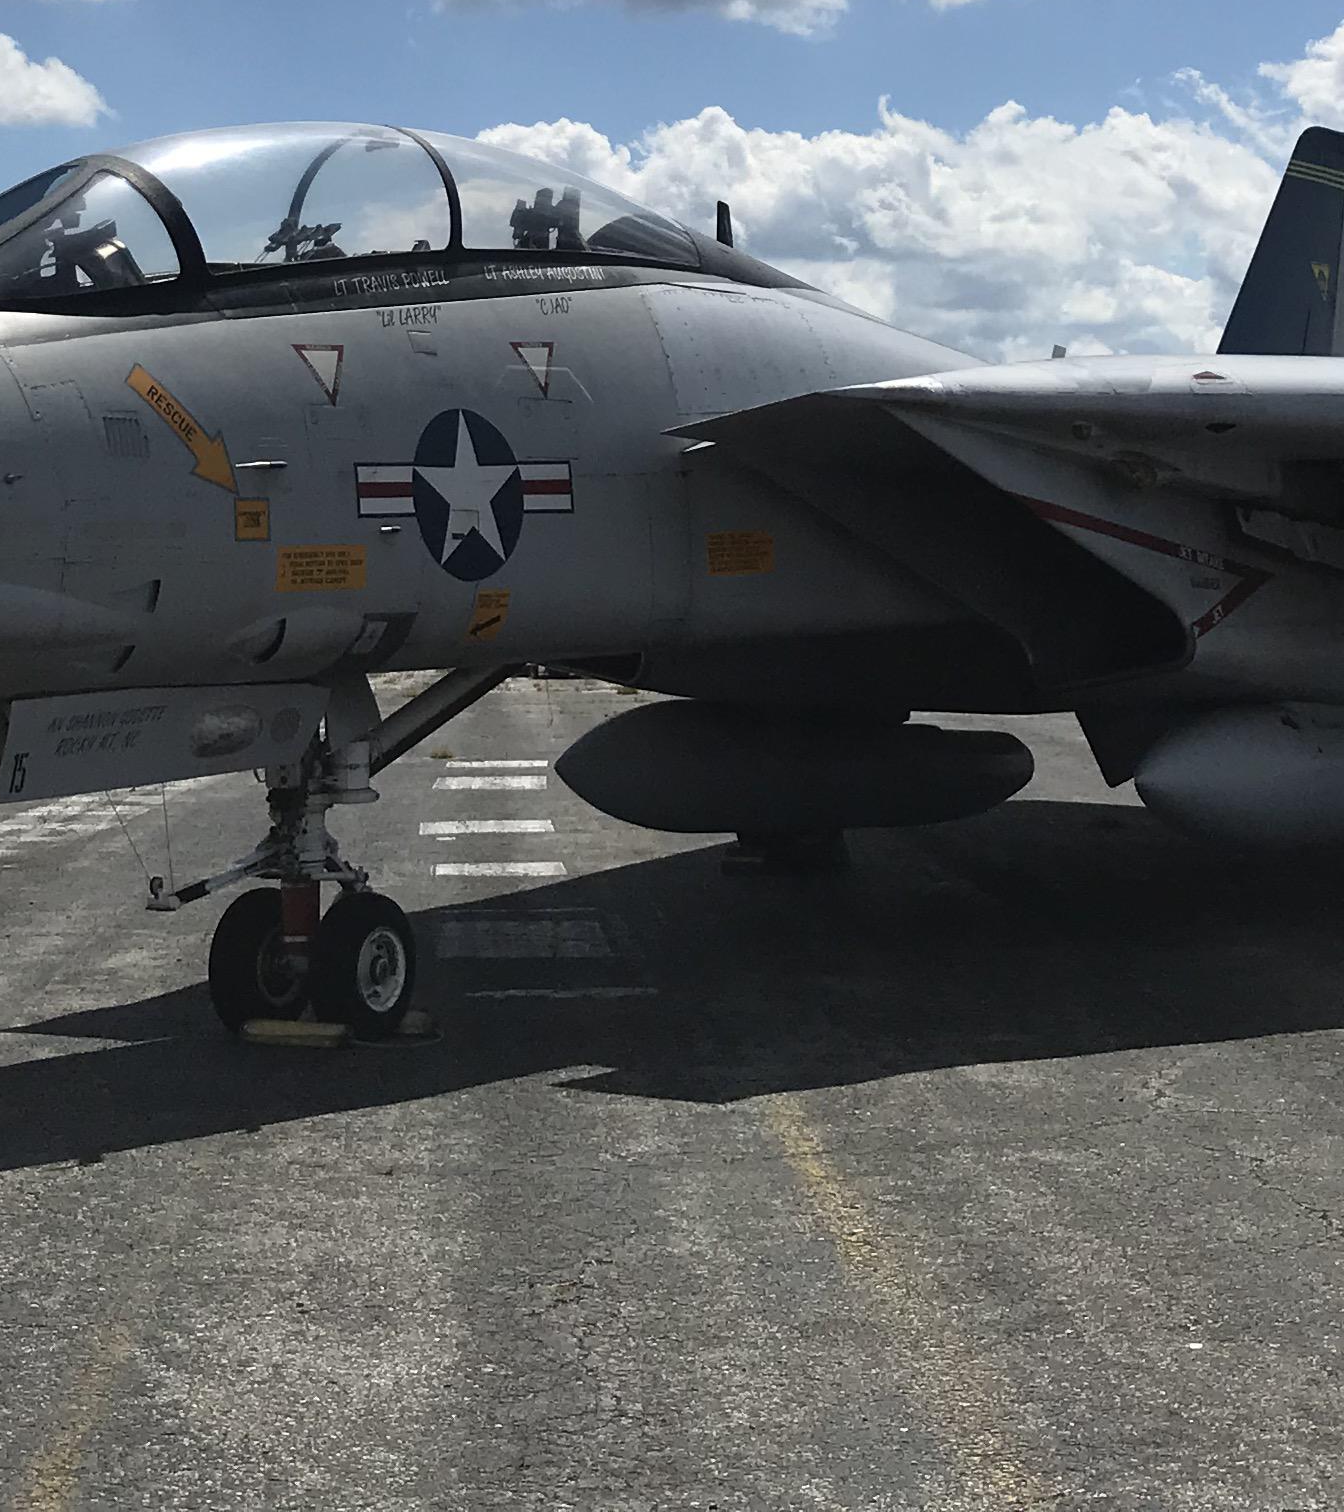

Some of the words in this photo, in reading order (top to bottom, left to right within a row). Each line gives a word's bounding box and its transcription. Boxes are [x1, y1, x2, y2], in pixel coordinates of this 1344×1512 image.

[333, 278, 348, 296] LT
[351, 273, 400, 296] TRAVIS
[401, 269, 451, 289] POWELL
[484, 264, 498, 281] LT
[146, 384, 198, 443] RESCUE
[9, 752, 30, 794] 15
